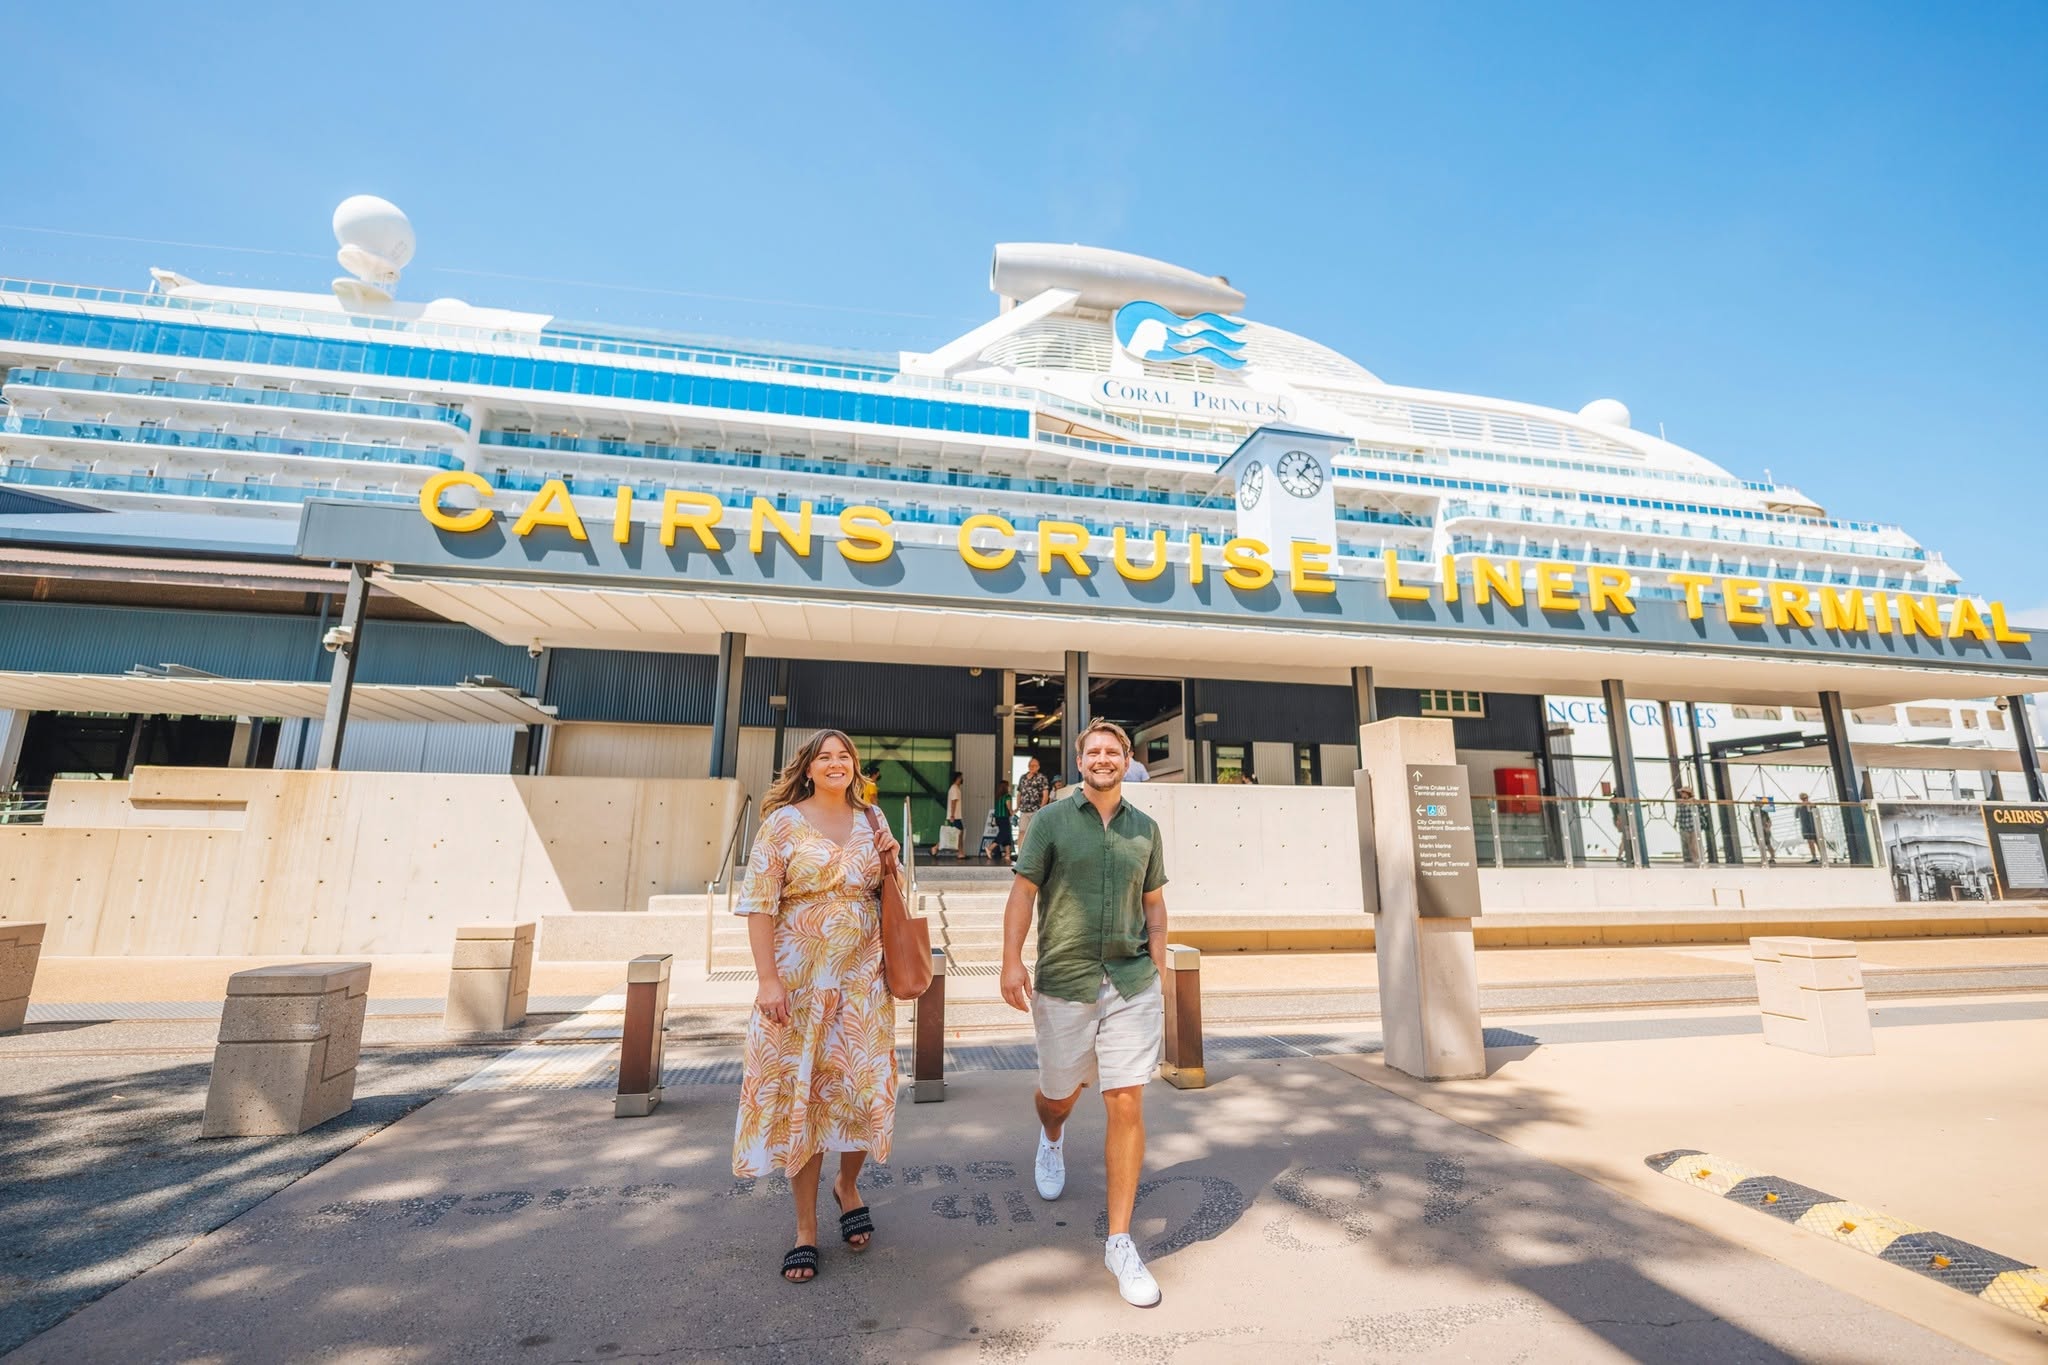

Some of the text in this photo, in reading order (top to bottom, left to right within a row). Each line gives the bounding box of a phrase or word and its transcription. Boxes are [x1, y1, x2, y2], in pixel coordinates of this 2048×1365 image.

[1103, 379, 1287, 420] CORAL PRINCESS
[420, 470, 2033, 644] CAIRNS CRUISE LINER TERMINAL
[1993, 809, 2044, 824] CAIRNS
